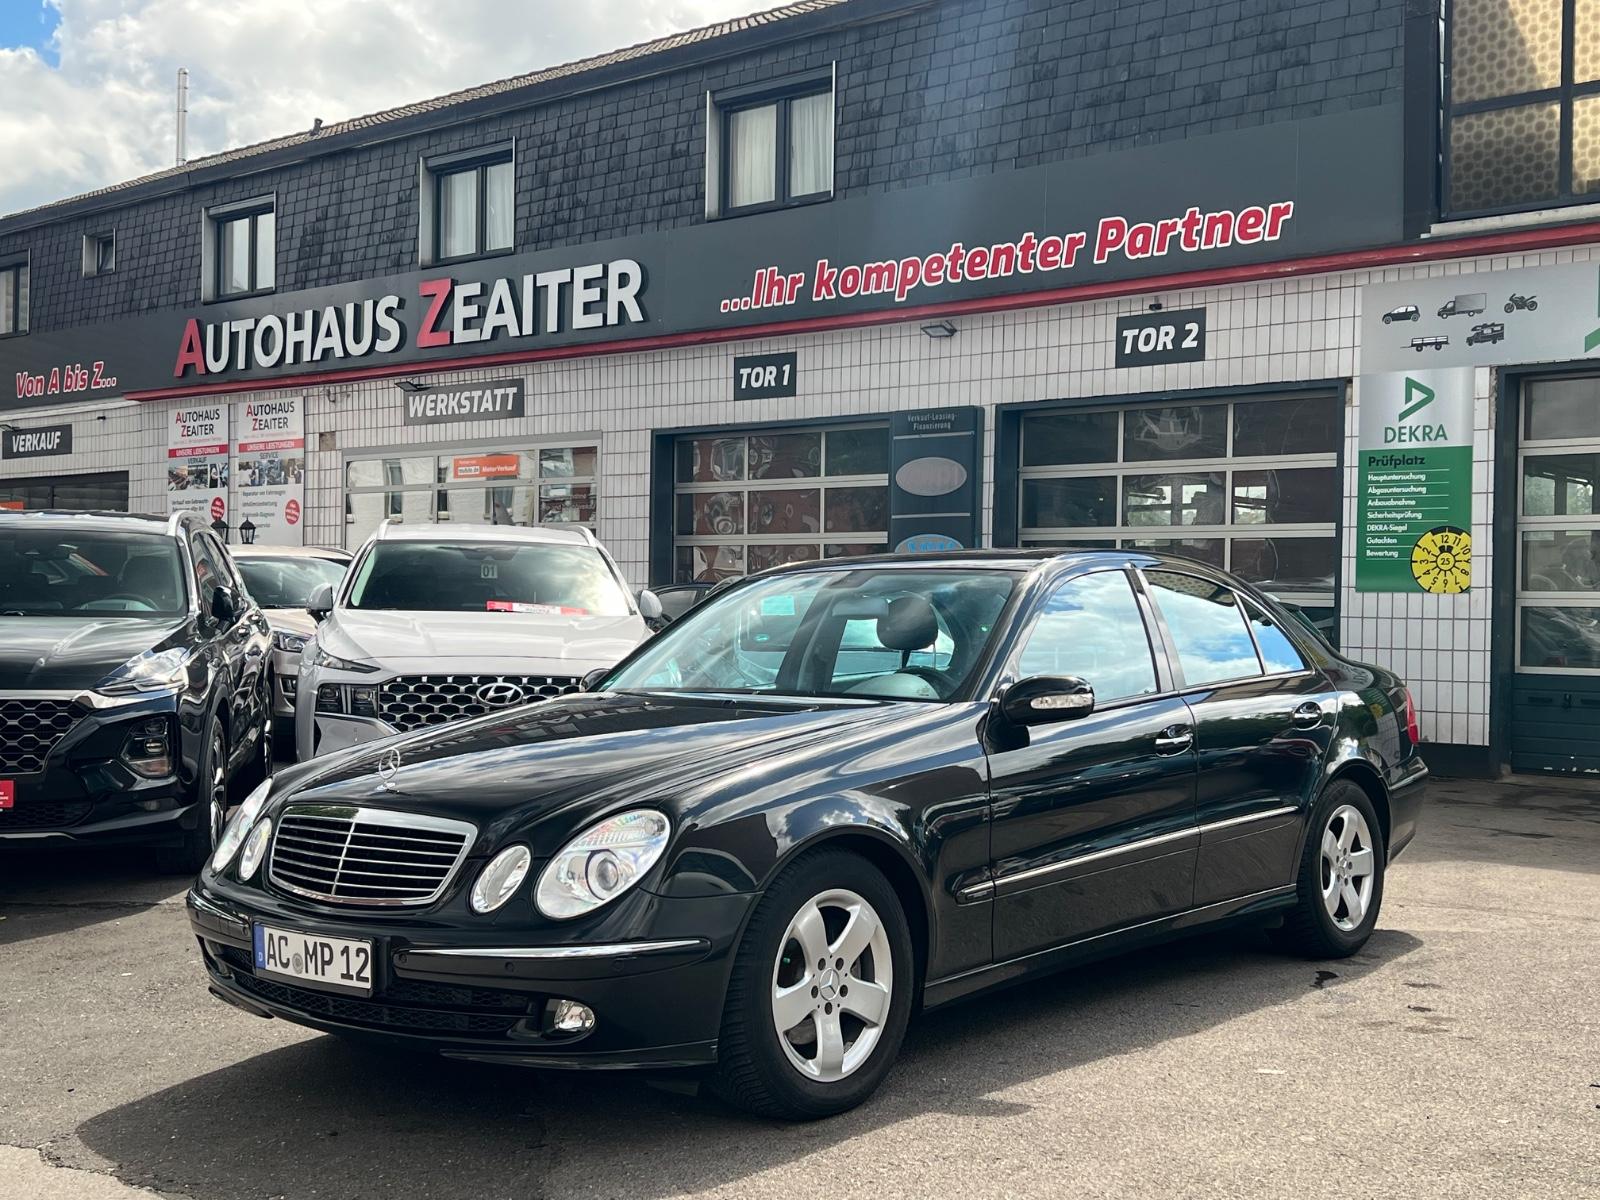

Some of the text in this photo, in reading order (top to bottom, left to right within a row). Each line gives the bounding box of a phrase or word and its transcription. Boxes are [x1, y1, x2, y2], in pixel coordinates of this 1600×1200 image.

[720, 201, 1294, 313] ...Ihr kompetenter Partner
[173, 259, 643, 377] AUTOHAUS ZEAITER
[1122, 322, 1199, 354] TOR 2
[16, 372, 45, 398] Von
[47, 367, 60, 395] A
[63, 364, 89, 392] bis
[740, 363, 791, 389] TOR 1
[246, 401, 295, 417] AUTOHAUS
[409, 386, 517, 418] WERKSTATT
[175, 409, 220, 424] AUTOHAUS
[181, 424, 214, 437] ZEAITER
[252, 417, 289, 431] ZEAITER
[1384, 424, 1448, 443] DEKRA
[12, 431, 61, 453] VERKAUF
[1368, 454, 1426, 469] Prüfplatz
[1368, 473, 1426, 482] Hauptuntersuchung
[1368, 485, 1427, 495] Abgasuntersuchung
[1368, 498, 1416, 506] Anbauabnahme
[1367, 511, 1422, 520] Sicherheitsprüfung
[1366, 523, 1408, 532] DEKRA-Siegel
[1441, 535, 1449, 543] 12
[1366, 550, 1398, 558] Bewertung
[1422, 547, 1431, 555] 2
[1461, 544, 1470, 555] 10
[483, 566, 494, 577] 01
[267, 933, 370, 983] AC MP 12
